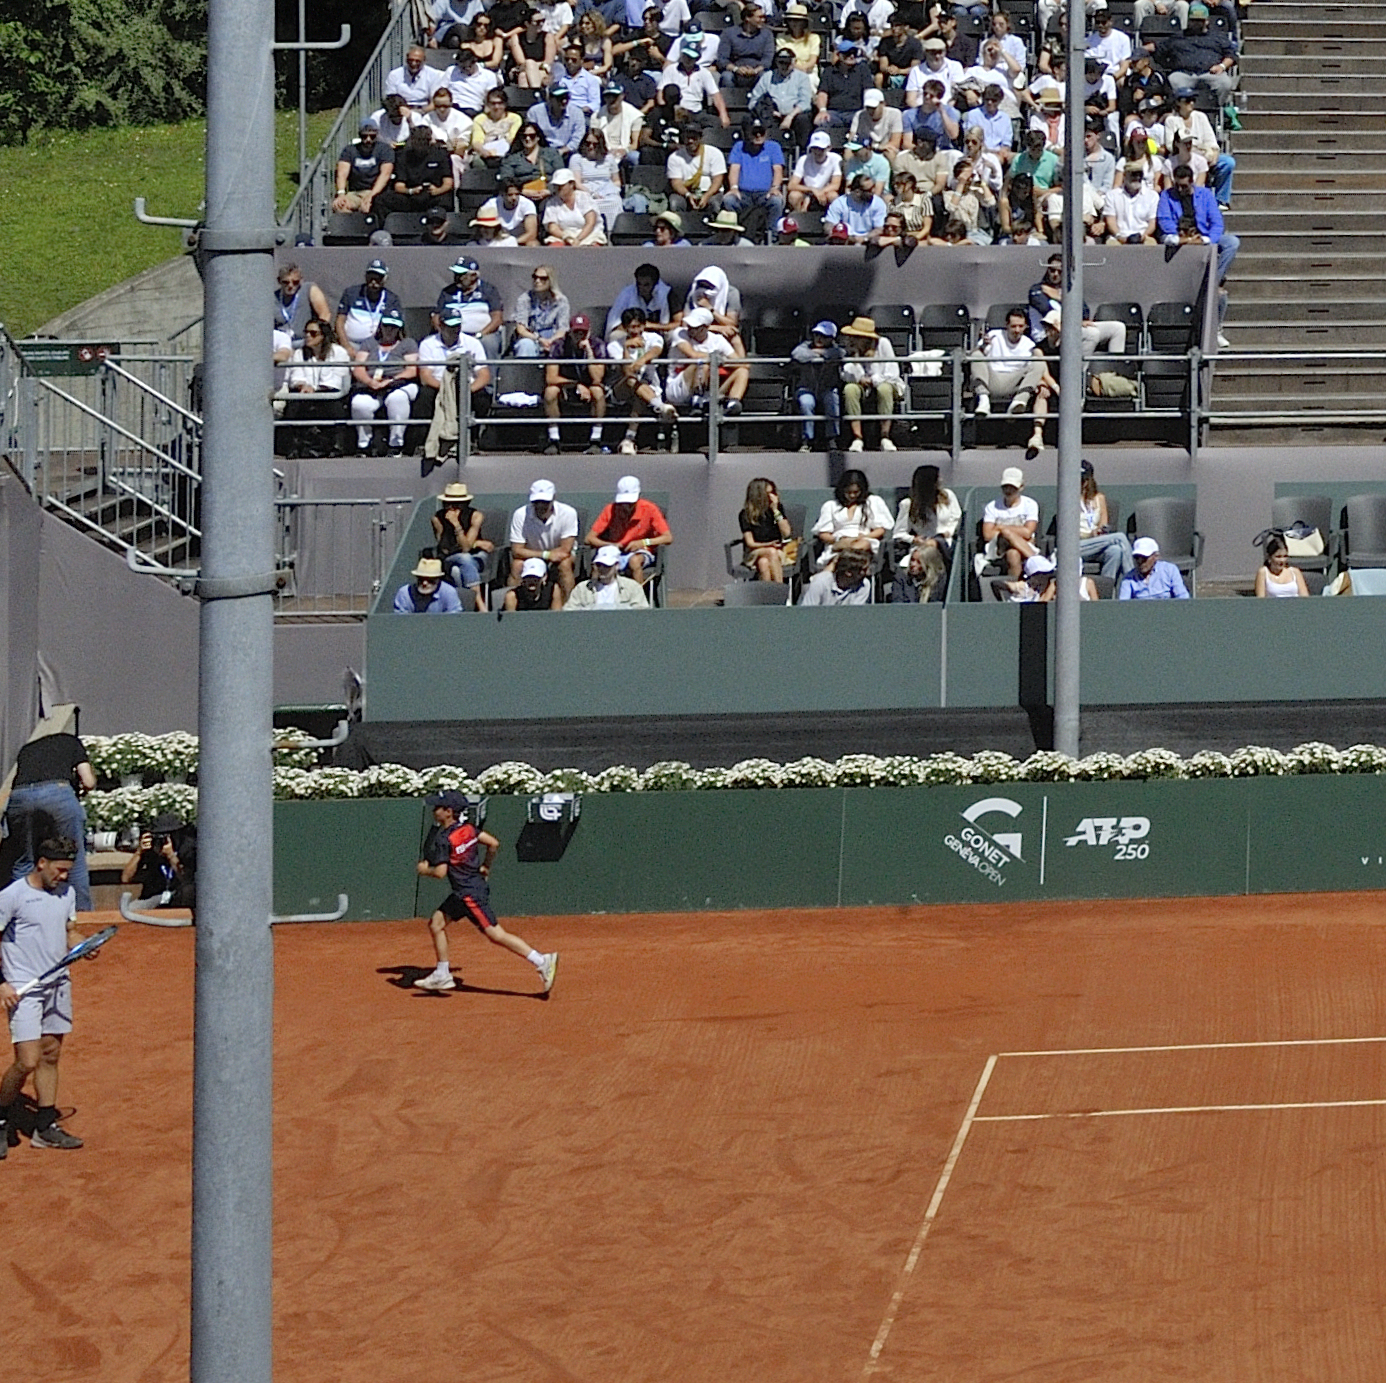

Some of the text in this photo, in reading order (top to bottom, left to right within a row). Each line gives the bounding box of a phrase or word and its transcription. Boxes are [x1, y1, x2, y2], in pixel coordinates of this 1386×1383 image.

[1062, 816, 1150, 846] ATP
[961, 827, 1011, 867] GONET
[1113, 844, 1150, 860] 250
